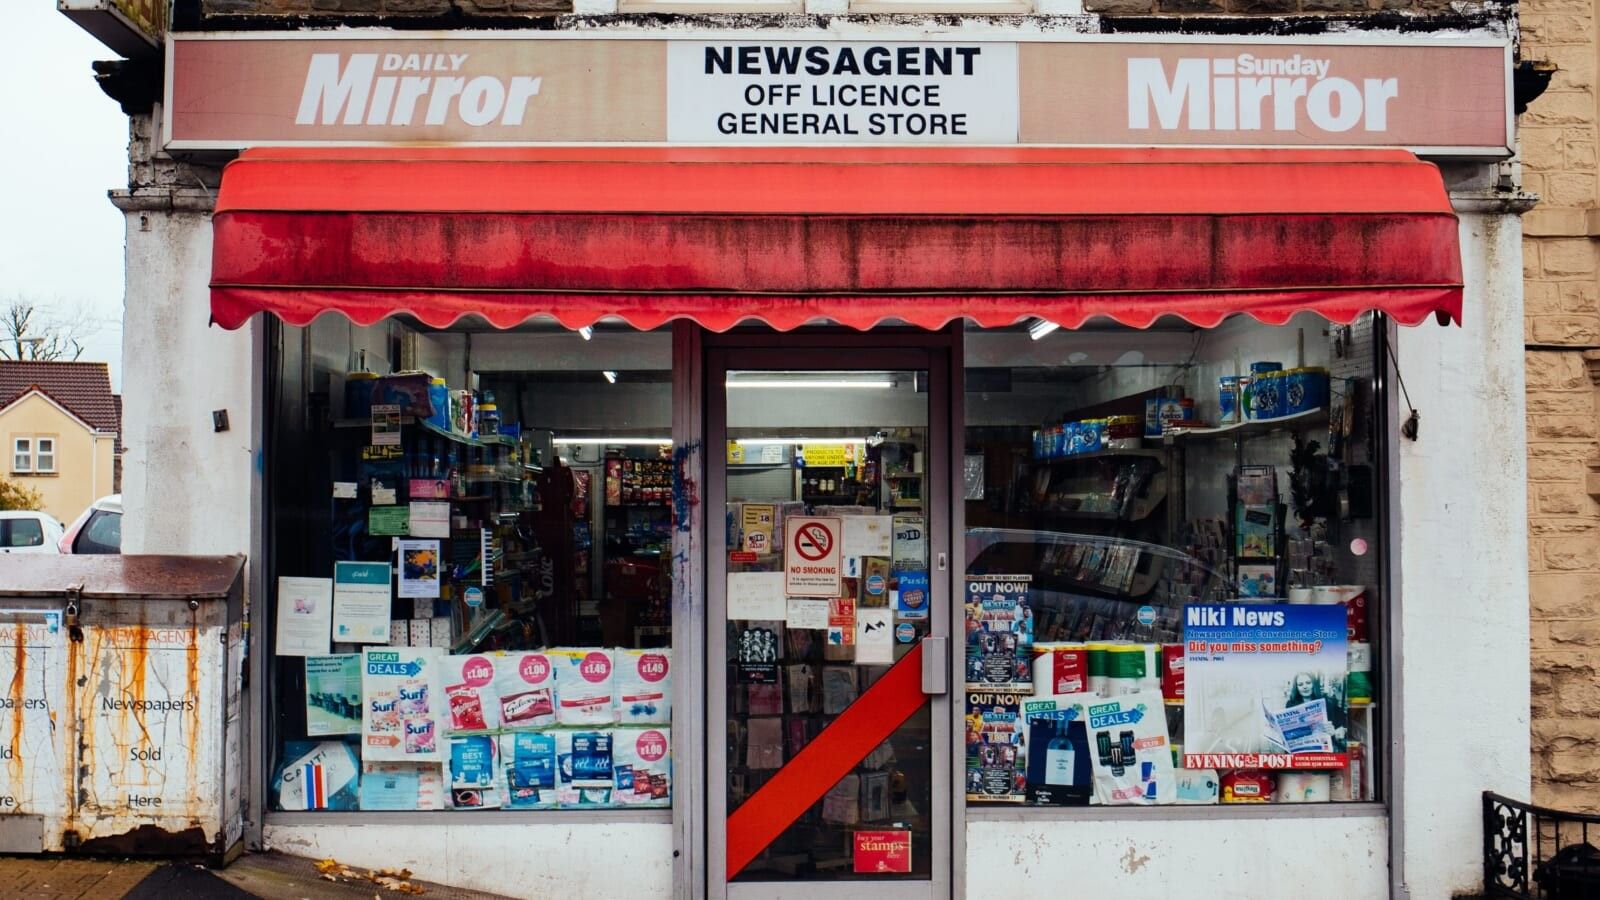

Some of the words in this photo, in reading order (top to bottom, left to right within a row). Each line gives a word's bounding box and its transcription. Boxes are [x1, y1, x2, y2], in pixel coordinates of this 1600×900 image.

[382, 53, 469, 72] DAILY
[704, 46, 981, 76] NEWSAGENT
[1237, 53, 1330, 80] Sunday
[295, 52, 541, 127] Mirror
[1127, 57, 1398, 132] Mirror
[744, 84, 801, 107] OFF
[812, 84, 940, 107] LICENCE
[717, 112, 859, 136] GENERAL
[868, 113, 968, 136] STORE
[790, 566, 801, 574] NO
[802, 566, 836, 575] SMOKING
[900, 575, 928, 585] Push
[970, 582, 993, 593] OUT
[995, 582, 1029, 593] NOW!
[1187, 607, 1226, 626] Niki
[1233, 607, 1285, 626] News
[1187, 630, 1234, 639] Newsagent
[1238, 630, 1252, 638] and
[1256, 630, 1312, 638] Convenience
[1313, 630, 1338, 639] Store
[1189, 641, 1206, 652] Did
[1209, 643, 1229, 655] you
[1231, 641, 1257, 652] miss
[1259, 640, 1323, 655] something?
[369, 653, 398, 661] GREAT
[369, 663, 408, 674] DEALS
[467, 668, 489, 679] £1.00
[523, 665, 545, 675] £1.00
[584, 663, 606, 674] £1.49
[642, 663, 664, 673] £1.49
[400, 688, 425, 700] Surf
[970, 694, 993, 705] OUT
[102, 697, 194, 714] Newspapers
[372, 701, 396, 712] Surf
[1027, 702, 1055, 711] GREAT
[1090, 704, 1118, 715] GREAT
[1092, 713, 1131, 728] DEALS
[406, 723, 432, 734] Surf
[130, 746, 161, 761] Sold
[640, 744, 662, 755] £1.00
[462, 752, 483, 760] BEST
[1186, 754, 1245, 769] EVENING
[1258, 754, 1293, 768] POST
[128, 794, 162, 808] Here
[860, 840, 904, 854] stamps
